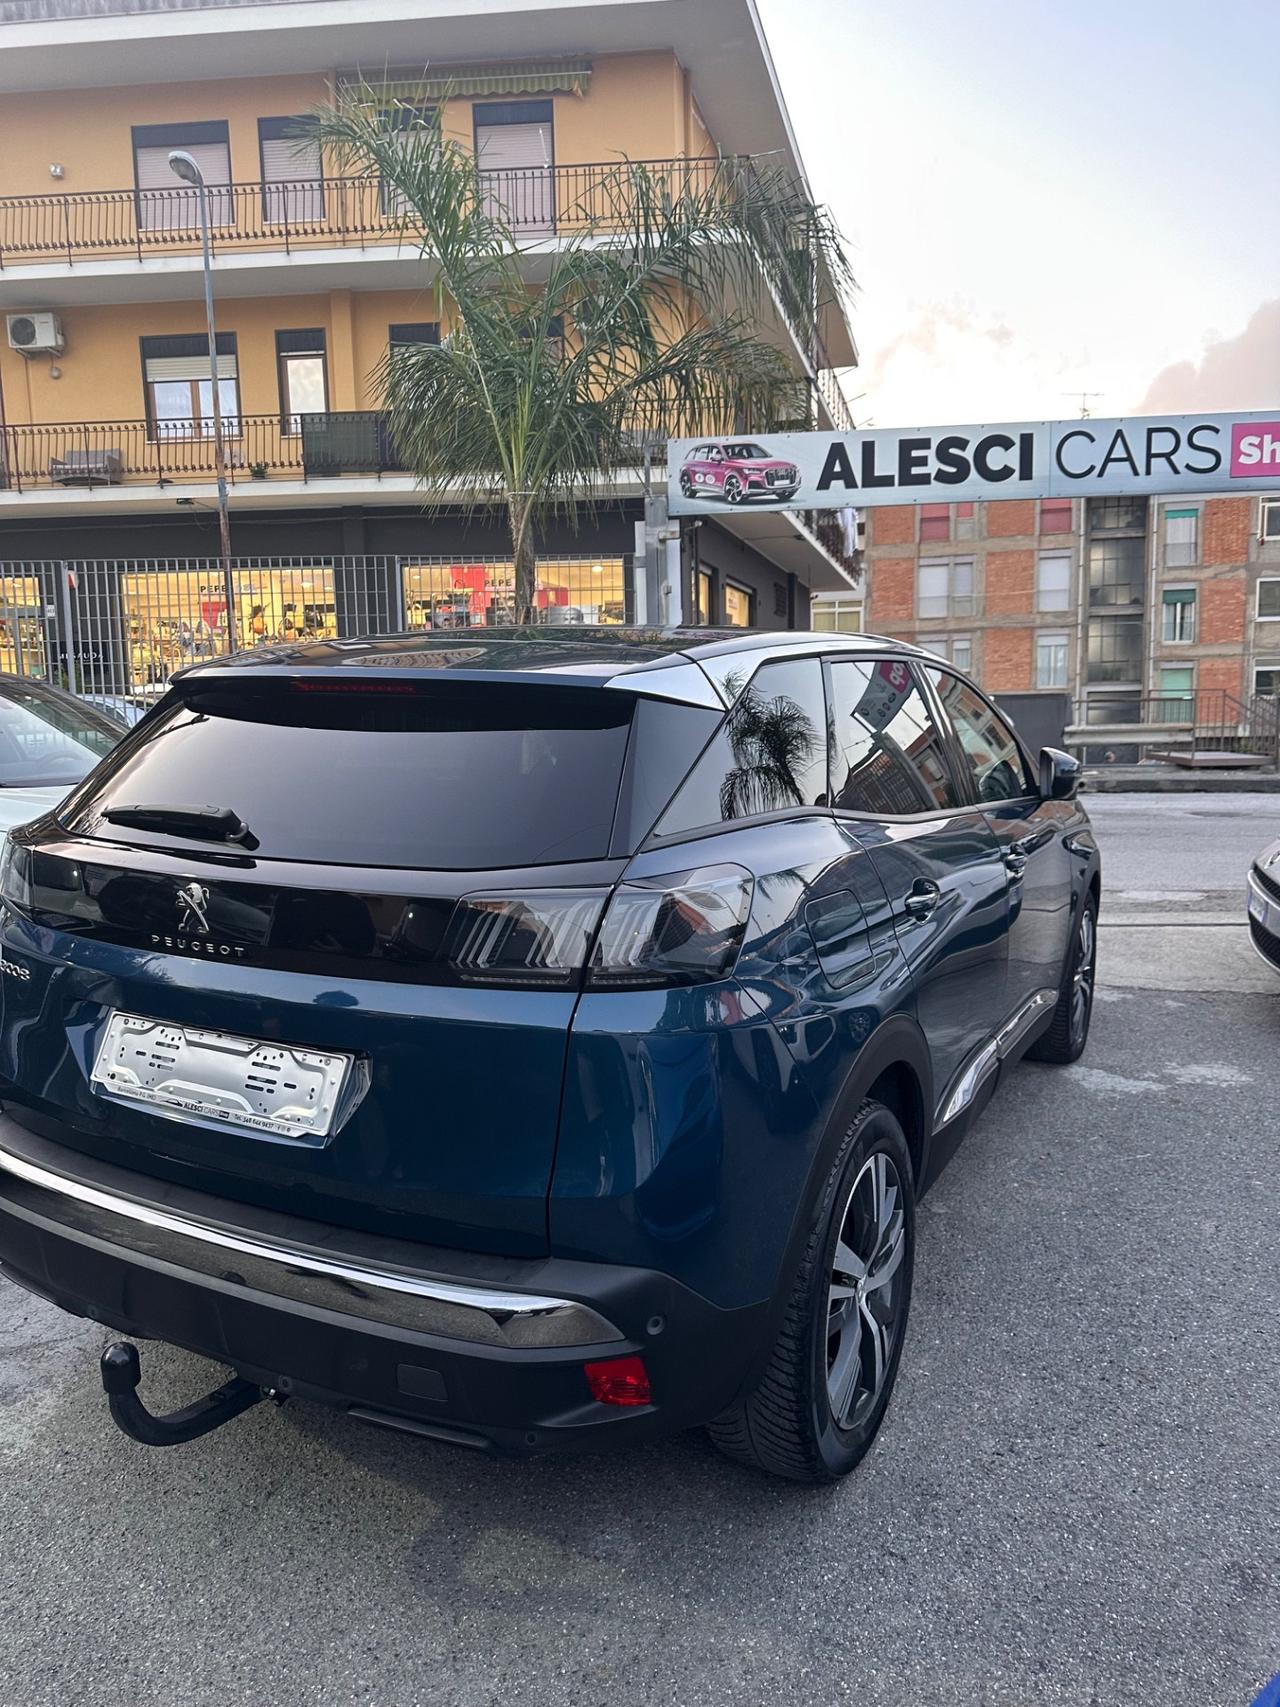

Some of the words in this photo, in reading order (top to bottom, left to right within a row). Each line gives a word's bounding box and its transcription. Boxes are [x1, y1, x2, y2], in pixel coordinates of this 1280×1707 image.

[816, 433, 1034, 491] ALESCI
[1055, 424, 1222, 480] CARS
[1238, 434, 1280, 465] Sh
[485, 579, 512, 587] PEPE
[151, 934, 245, 957] PEUGEOT
[183, 1102, 203, 1112] ALESCI
